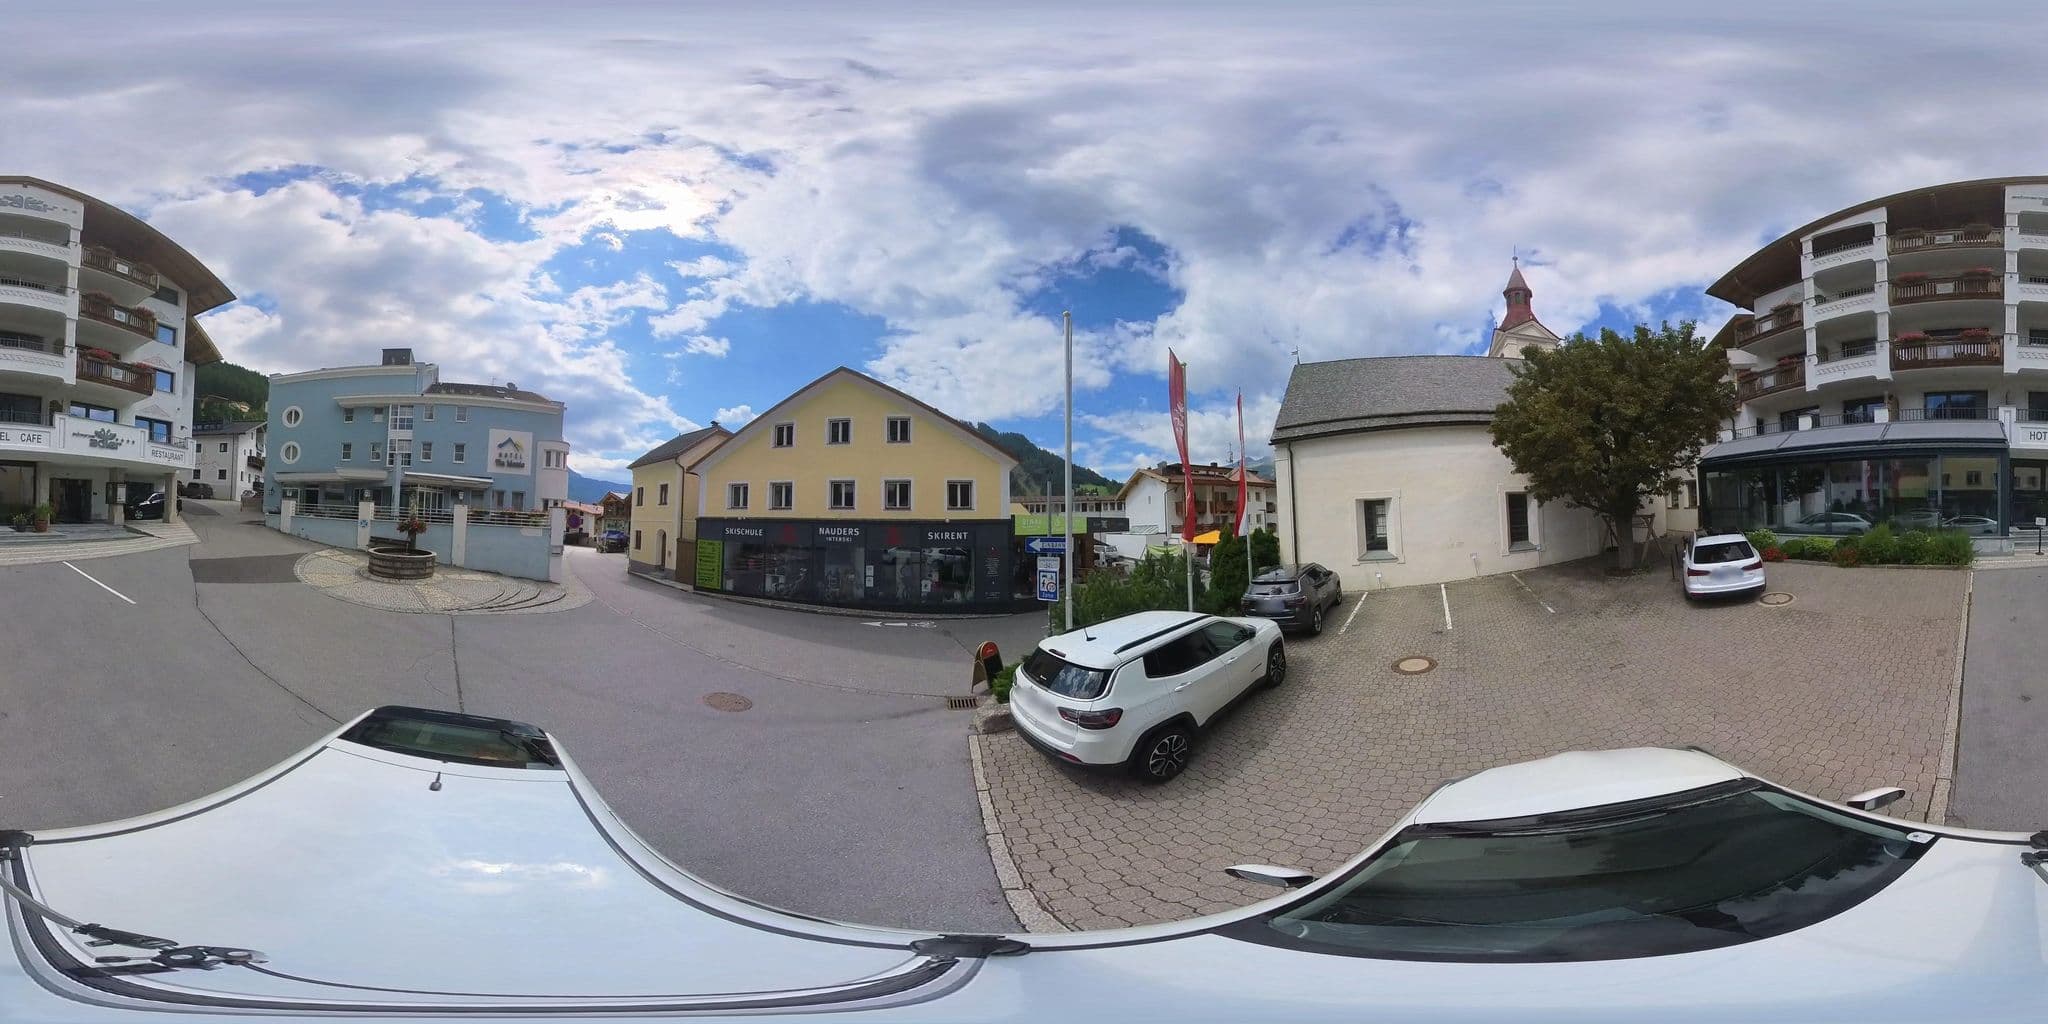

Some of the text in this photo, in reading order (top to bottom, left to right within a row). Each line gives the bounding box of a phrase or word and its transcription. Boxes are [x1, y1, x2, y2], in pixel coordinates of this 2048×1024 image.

[20, 433, 42, 444] CAFE
[151, 449, 184, 462] RESTAURANT
[725, 527, 763, 537] SKISCHULE
[819, 527, 860, 537] NAUDERS
[927, 531, 969, 541] SKIRENT
